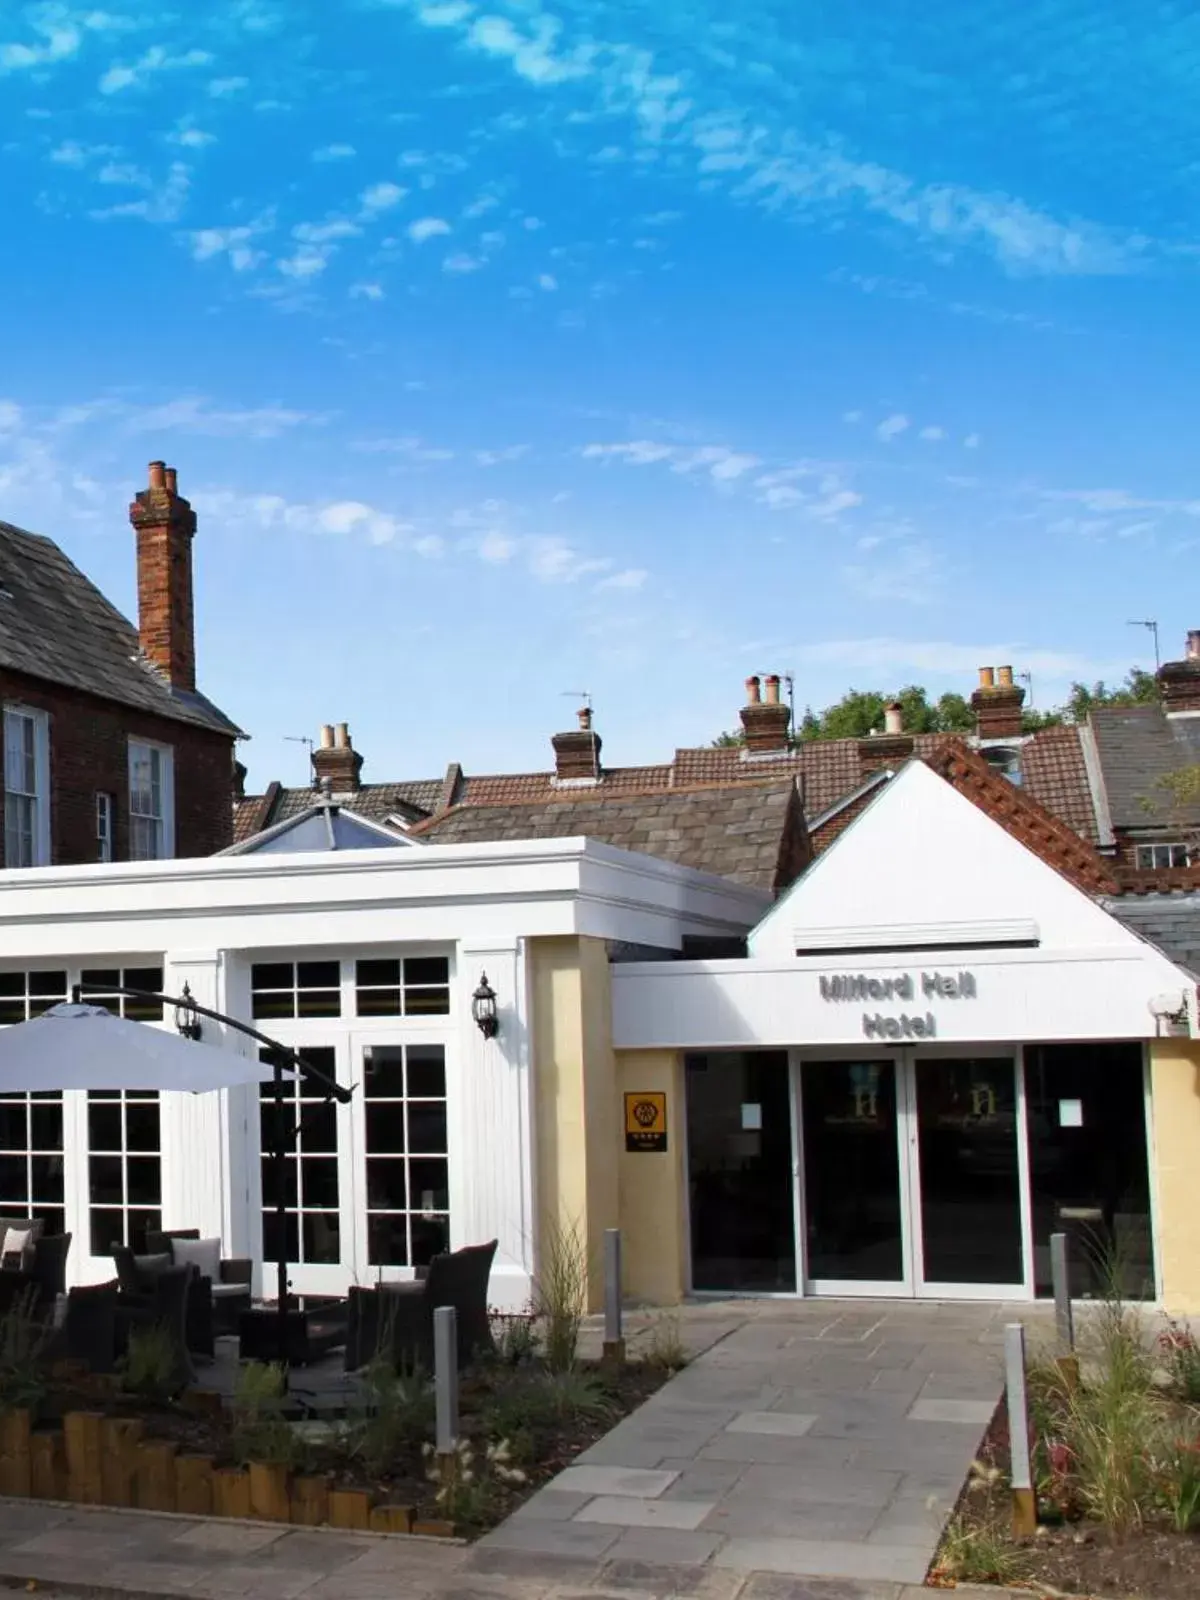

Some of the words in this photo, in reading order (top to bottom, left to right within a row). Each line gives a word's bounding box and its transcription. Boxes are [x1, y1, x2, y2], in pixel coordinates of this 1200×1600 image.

[819, 973, 914, 1002] Milford
[921, 971, 977, 999] Hall
[862, 1011, 937, 1039] Hotel
